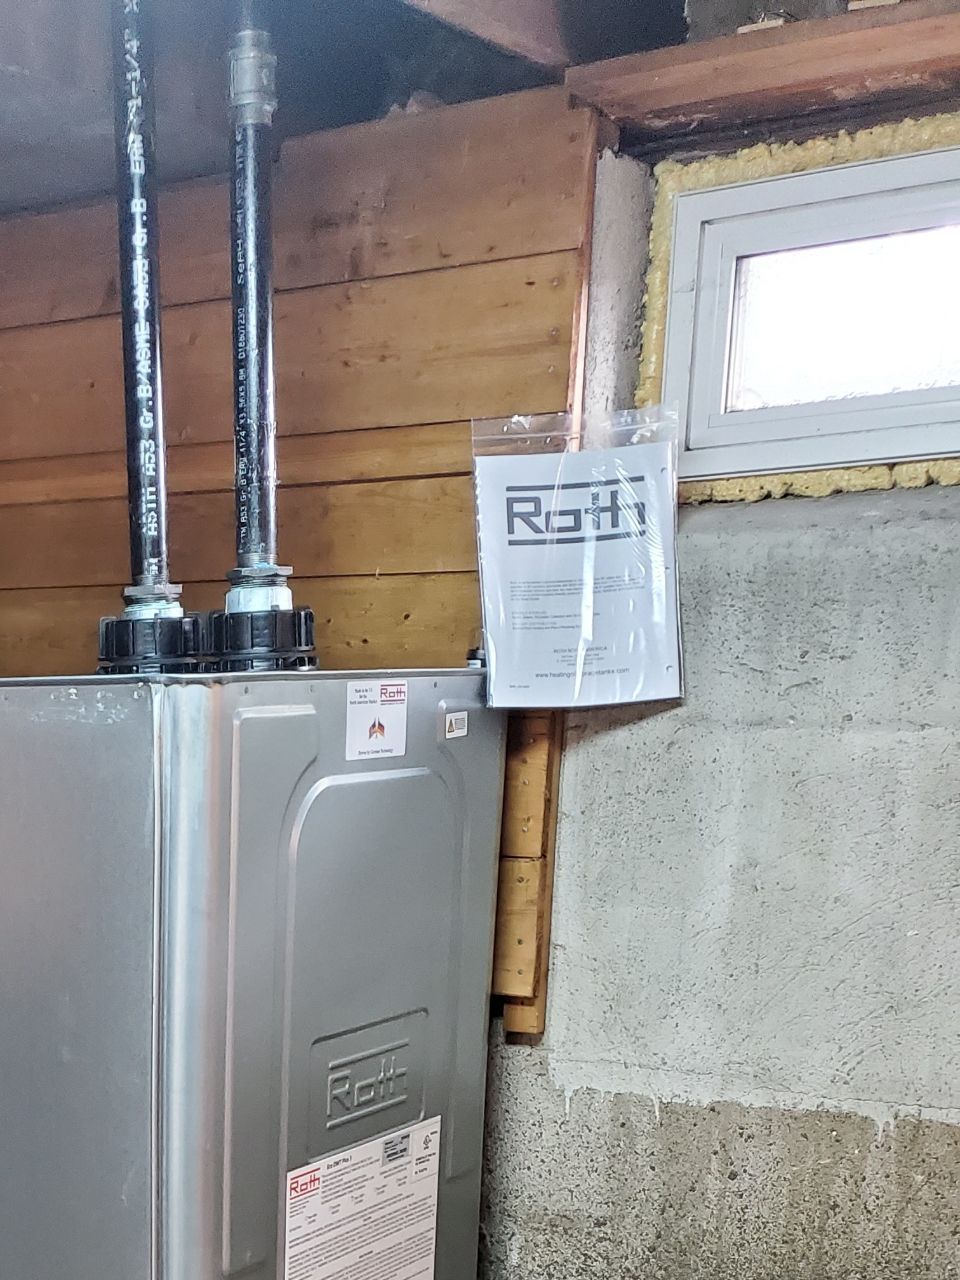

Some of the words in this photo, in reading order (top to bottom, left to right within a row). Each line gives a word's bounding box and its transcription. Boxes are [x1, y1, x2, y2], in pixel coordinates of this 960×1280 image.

[140, 439, 156, 476] A53
[506, 489, 646, 535] Roth
[380, 687, 406, 699] Roth
[327, 1055, 408, 1117] Roth
[290, 1173, 321, 1197] Roth
